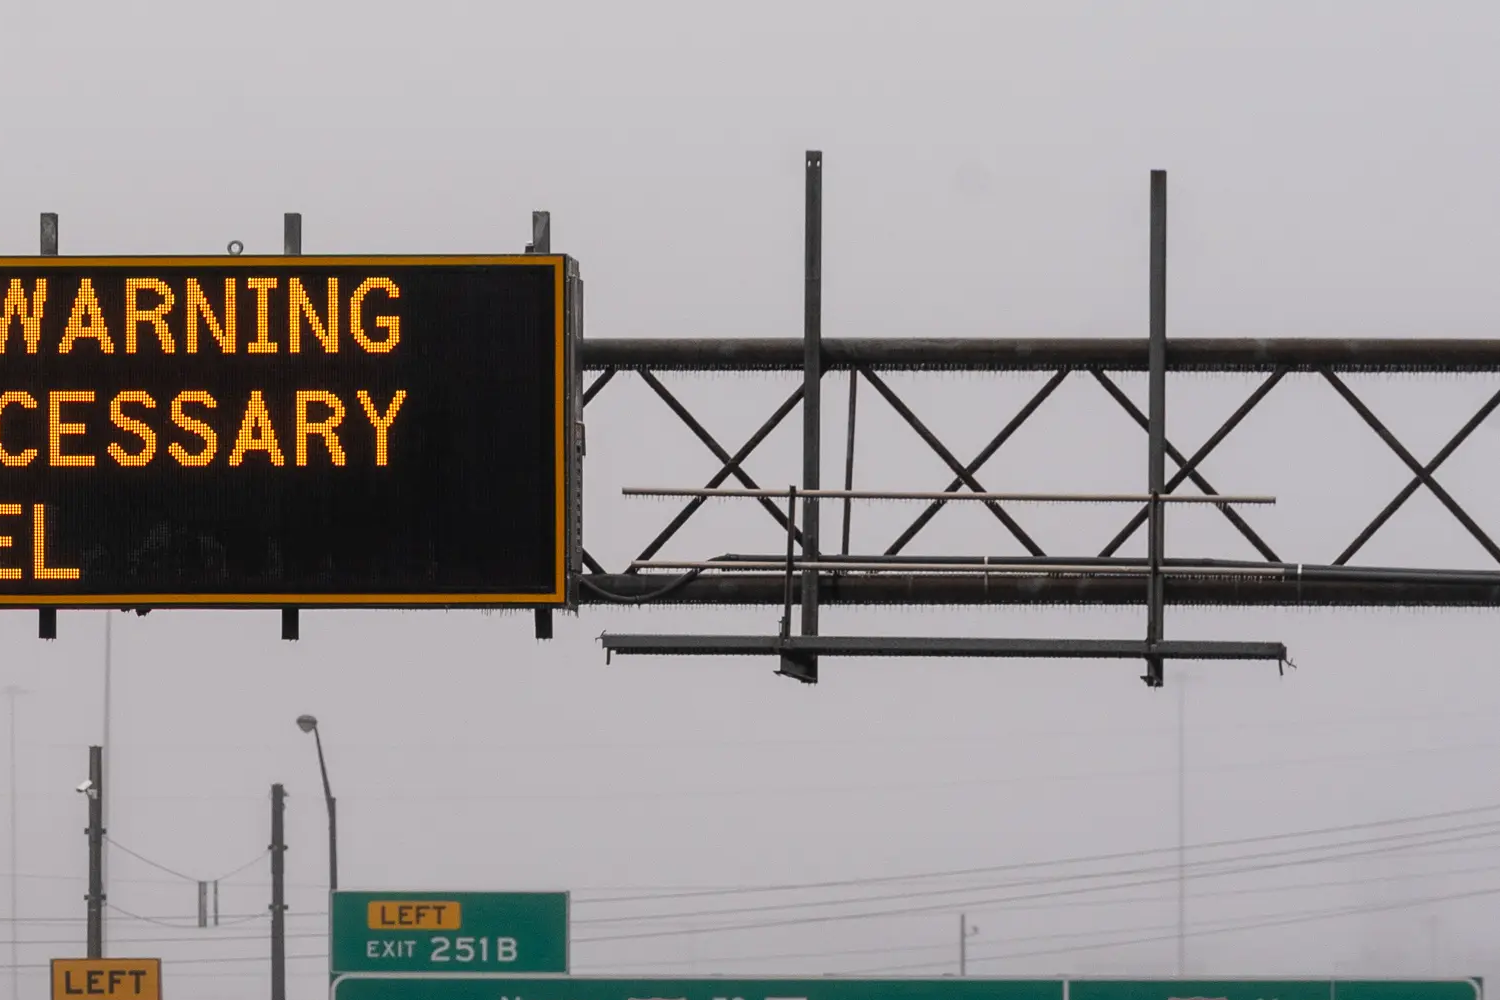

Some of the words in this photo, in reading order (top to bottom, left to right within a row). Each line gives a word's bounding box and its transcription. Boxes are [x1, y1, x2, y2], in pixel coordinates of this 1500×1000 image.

[380, 905, 448, 926] LEFT
[366, 940, 418, 959] EXIT
[430, 936, 520, 963] 251B
[64, 969, 148, 996] LEFT
